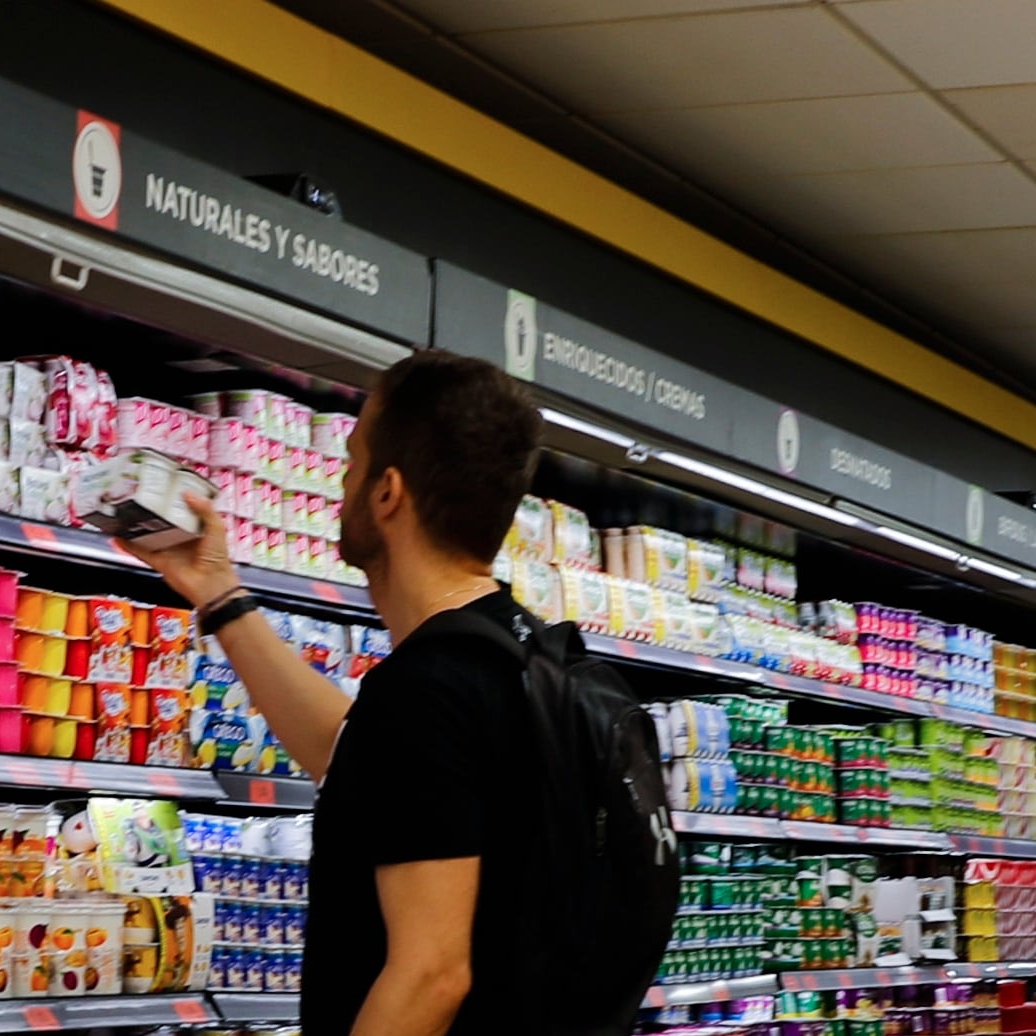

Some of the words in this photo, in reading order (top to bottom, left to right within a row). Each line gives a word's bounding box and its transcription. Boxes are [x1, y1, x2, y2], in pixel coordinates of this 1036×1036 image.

[146, 173, 271, 252] NATURALES
[274, 225, 290, 259] Y
[292, 233, 380, 296] SABORES
